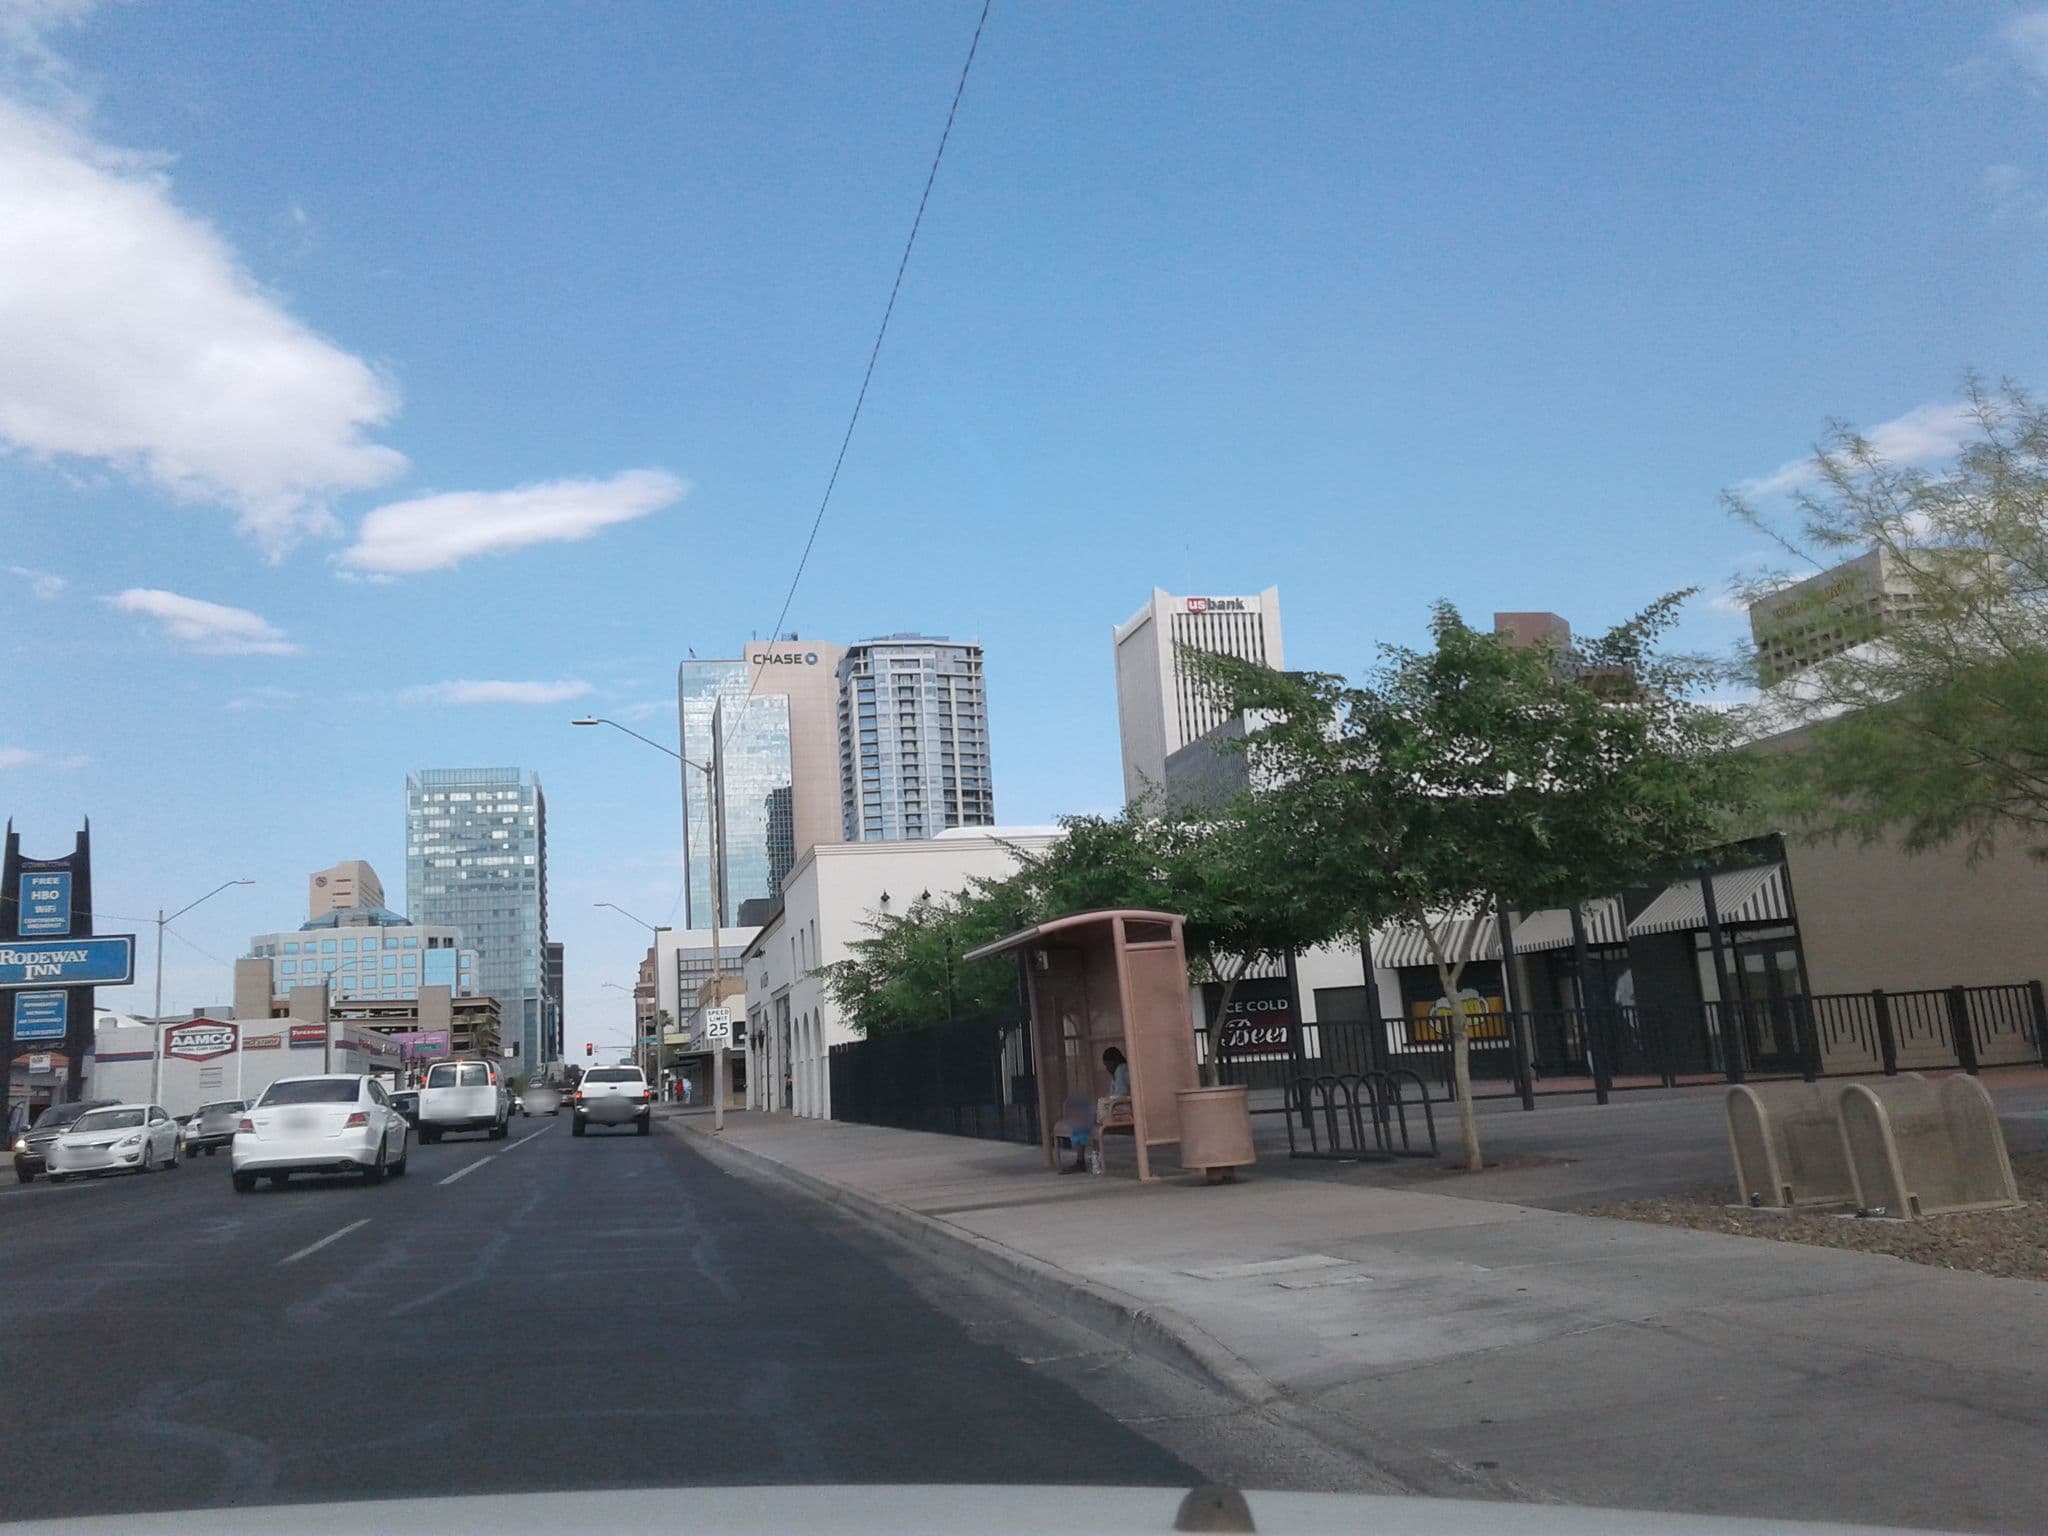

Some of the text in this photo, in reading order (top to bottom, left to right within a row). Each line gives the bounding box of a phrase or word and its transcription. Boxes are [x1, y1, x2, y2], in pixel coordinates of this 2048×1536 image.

[753, 653, 803, 665] CHASE
[32, 877, 60, 885] FREE
[31, 890, 60, 900] HBO
[24, 963, 62, 980] INN
[1225, 999, 1289, 1014] CE COLD
[709, 1022, 729, 1037] 25
[170, 1033, 236, 1047] AAMCO
